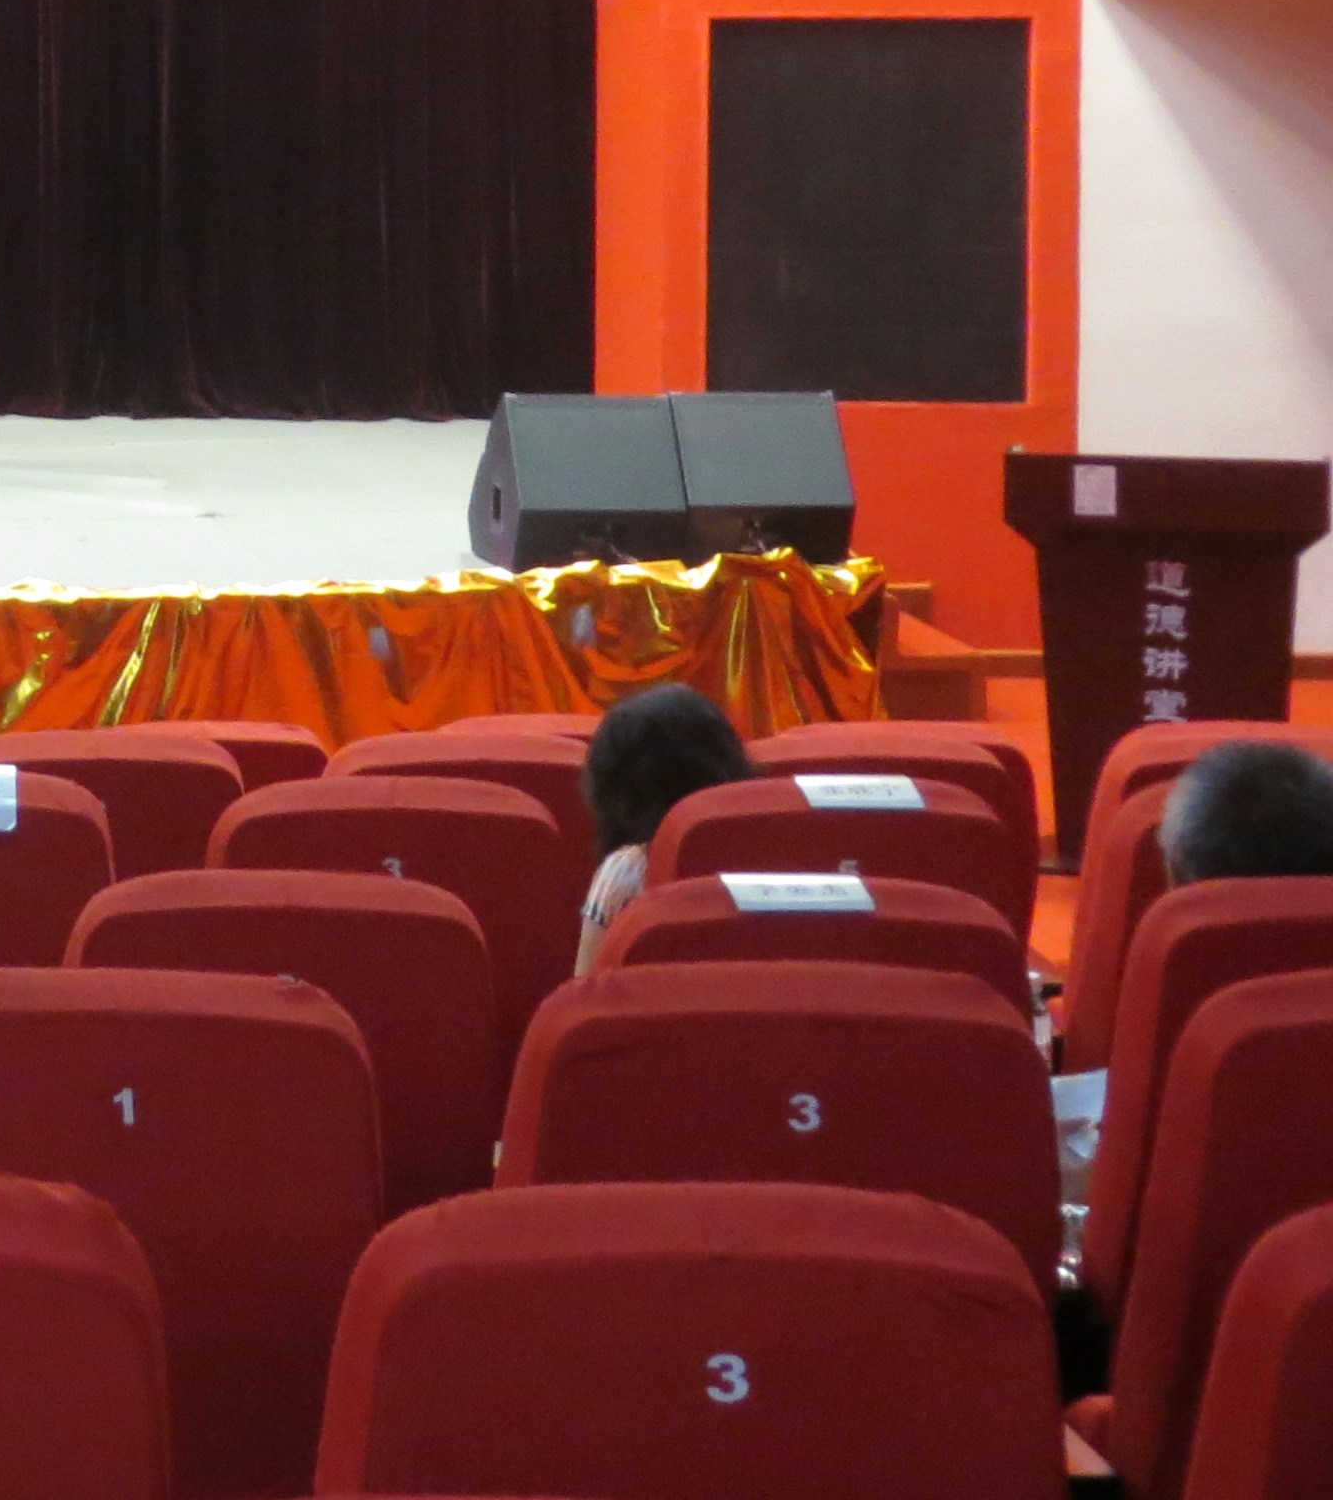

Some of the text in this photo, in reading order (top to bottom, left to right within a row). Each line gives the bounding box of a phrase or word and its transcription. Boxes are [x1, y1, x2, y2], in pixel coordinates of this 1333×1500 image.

[111, 1086, 137, 1126] 1
[787, 1092, 823, 1133] 3
[705, 1352, 751, 1405] 3
